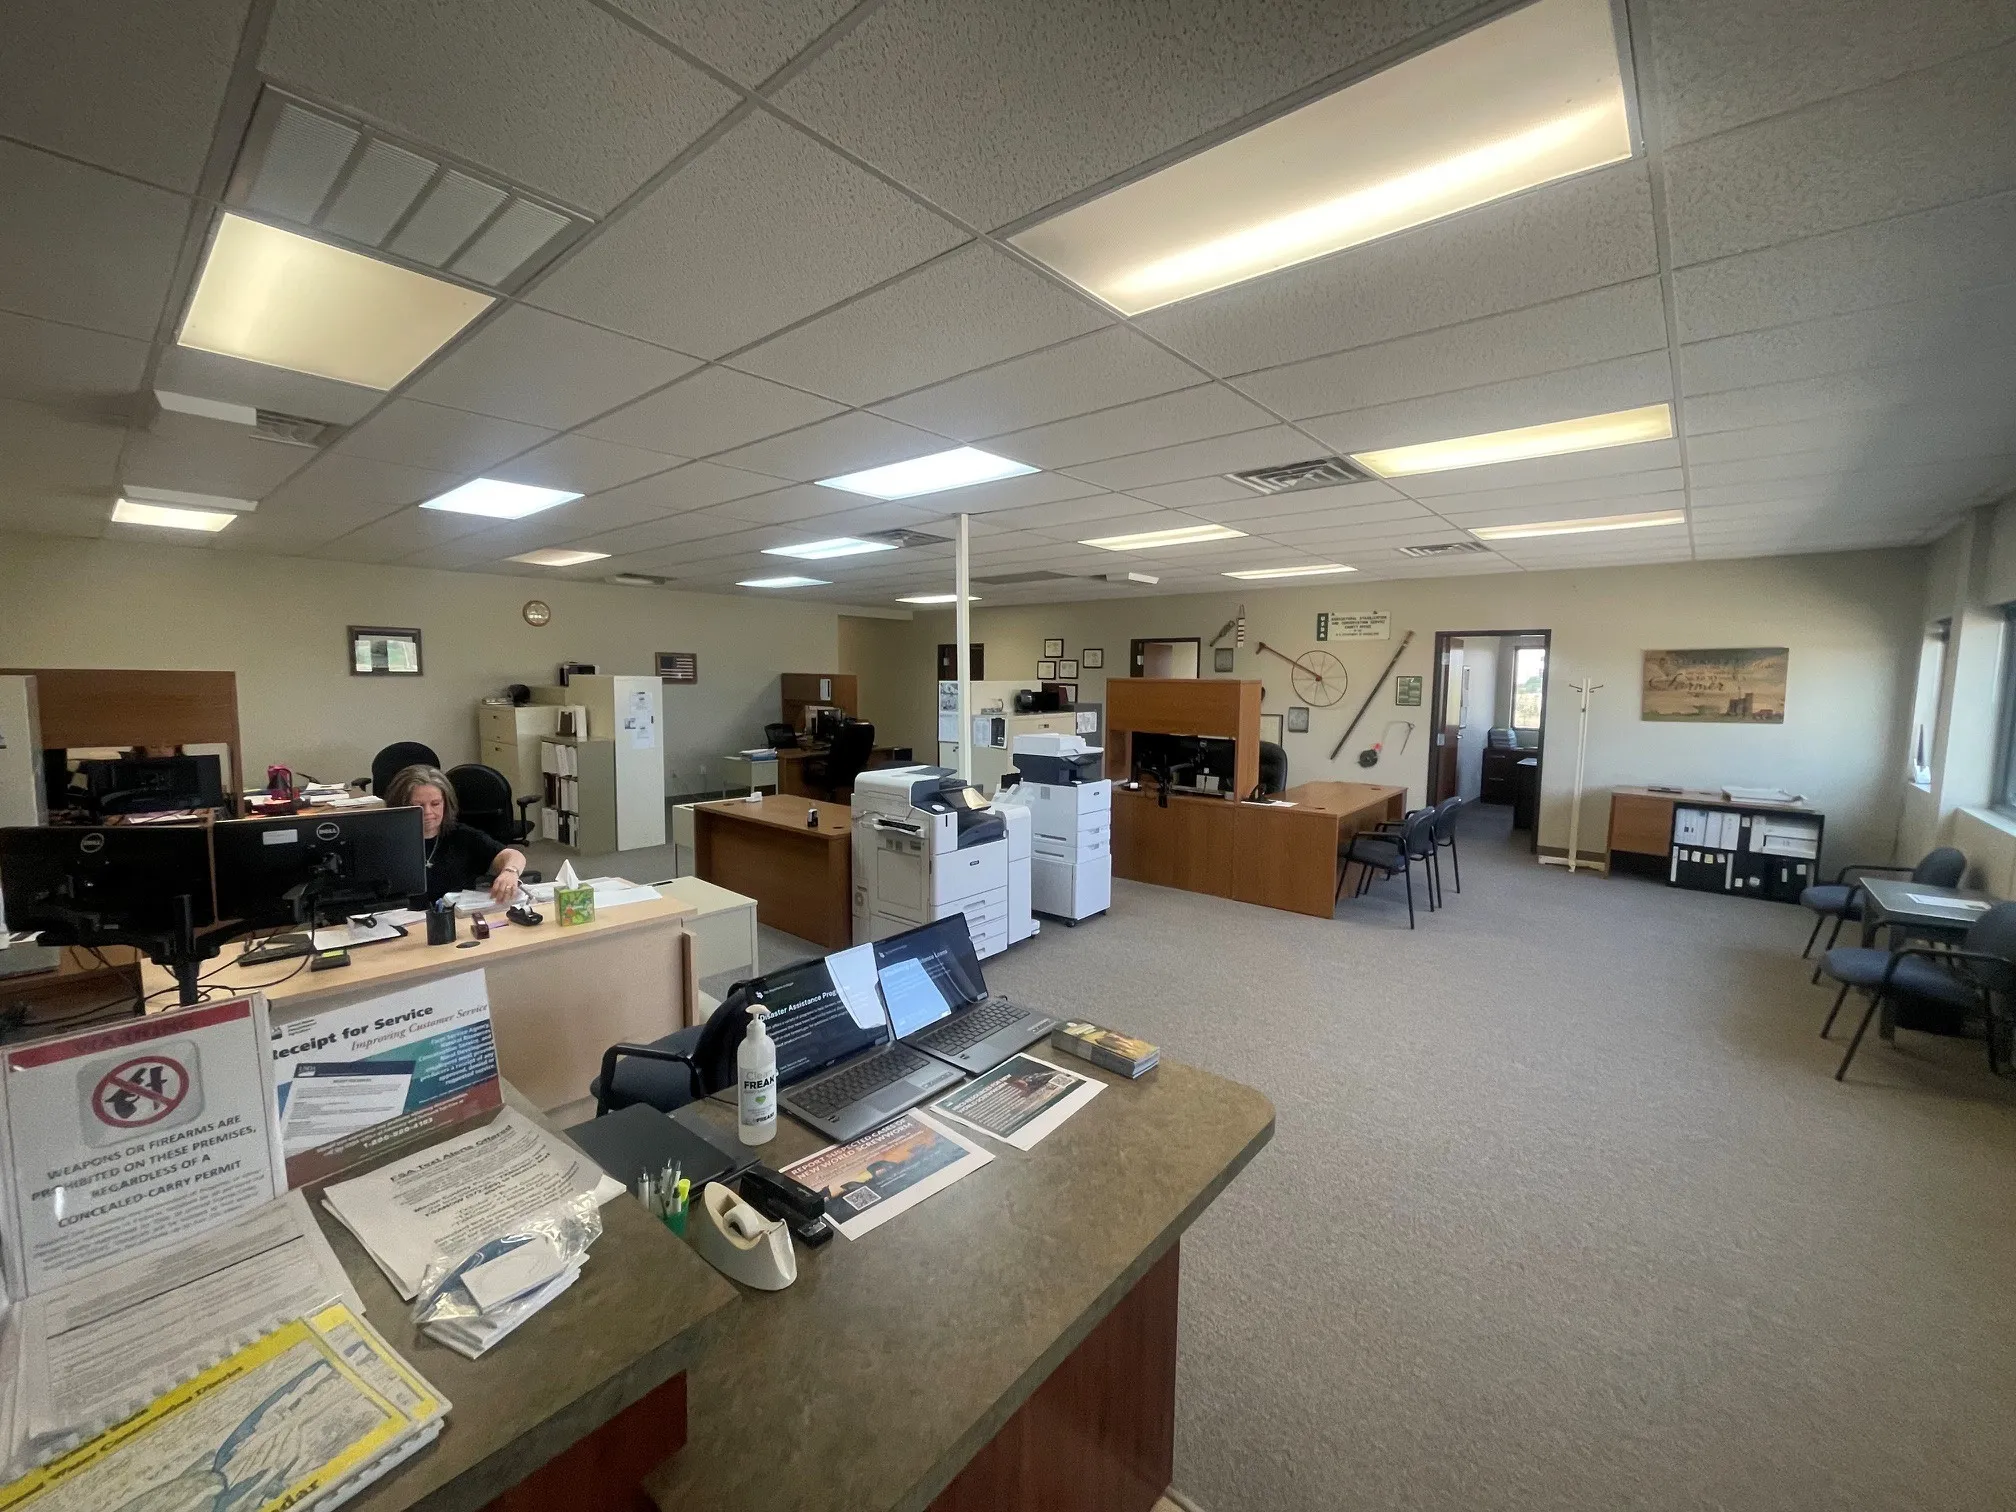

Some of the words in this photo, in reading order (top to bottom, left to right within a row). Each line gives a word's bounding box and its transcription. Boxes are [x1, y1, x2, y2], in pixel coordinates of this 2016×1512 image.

[342, 1024, 369, 1039] for
[374, 1006, 433, 1030] Service
[351, 1029, 406, 1051] Improving
[408, 1014, 453, 1032] Customer
[456, 1004, 489, 1019] Service
[760, 1006, 787, 1021] Disaster
[789, 995, 822, 1012] Assistance
[744, 1075, 774, 1089] FREAK
[47, 1152, 121, 1180] WEAPONS
[125, 1144, 146, 1157] OR
[149, 1124, 214, 1149] FIREARMS
[217, 1115, 241, 1129] ARE
[123, 1159, 145, 1172] ON
[150, 1145, 188, 1165] THESE
[193, 1126, 257, 1150] PREMISES,
[791, 1156, 826, 1176] REPORT
[797, 1167, 821, 1181] NEW
[821, 1149, 856, 1171] WORLD
[58, 1177, 192, 1228] CONCEALED-CARRY
[194, 1160, 242, 1183] PERMIT
[90, 1164, 178, 1199] REGARDLESS
[181, 1158, 198, 1170] OF
[201, 1154, 211, 1163] A
